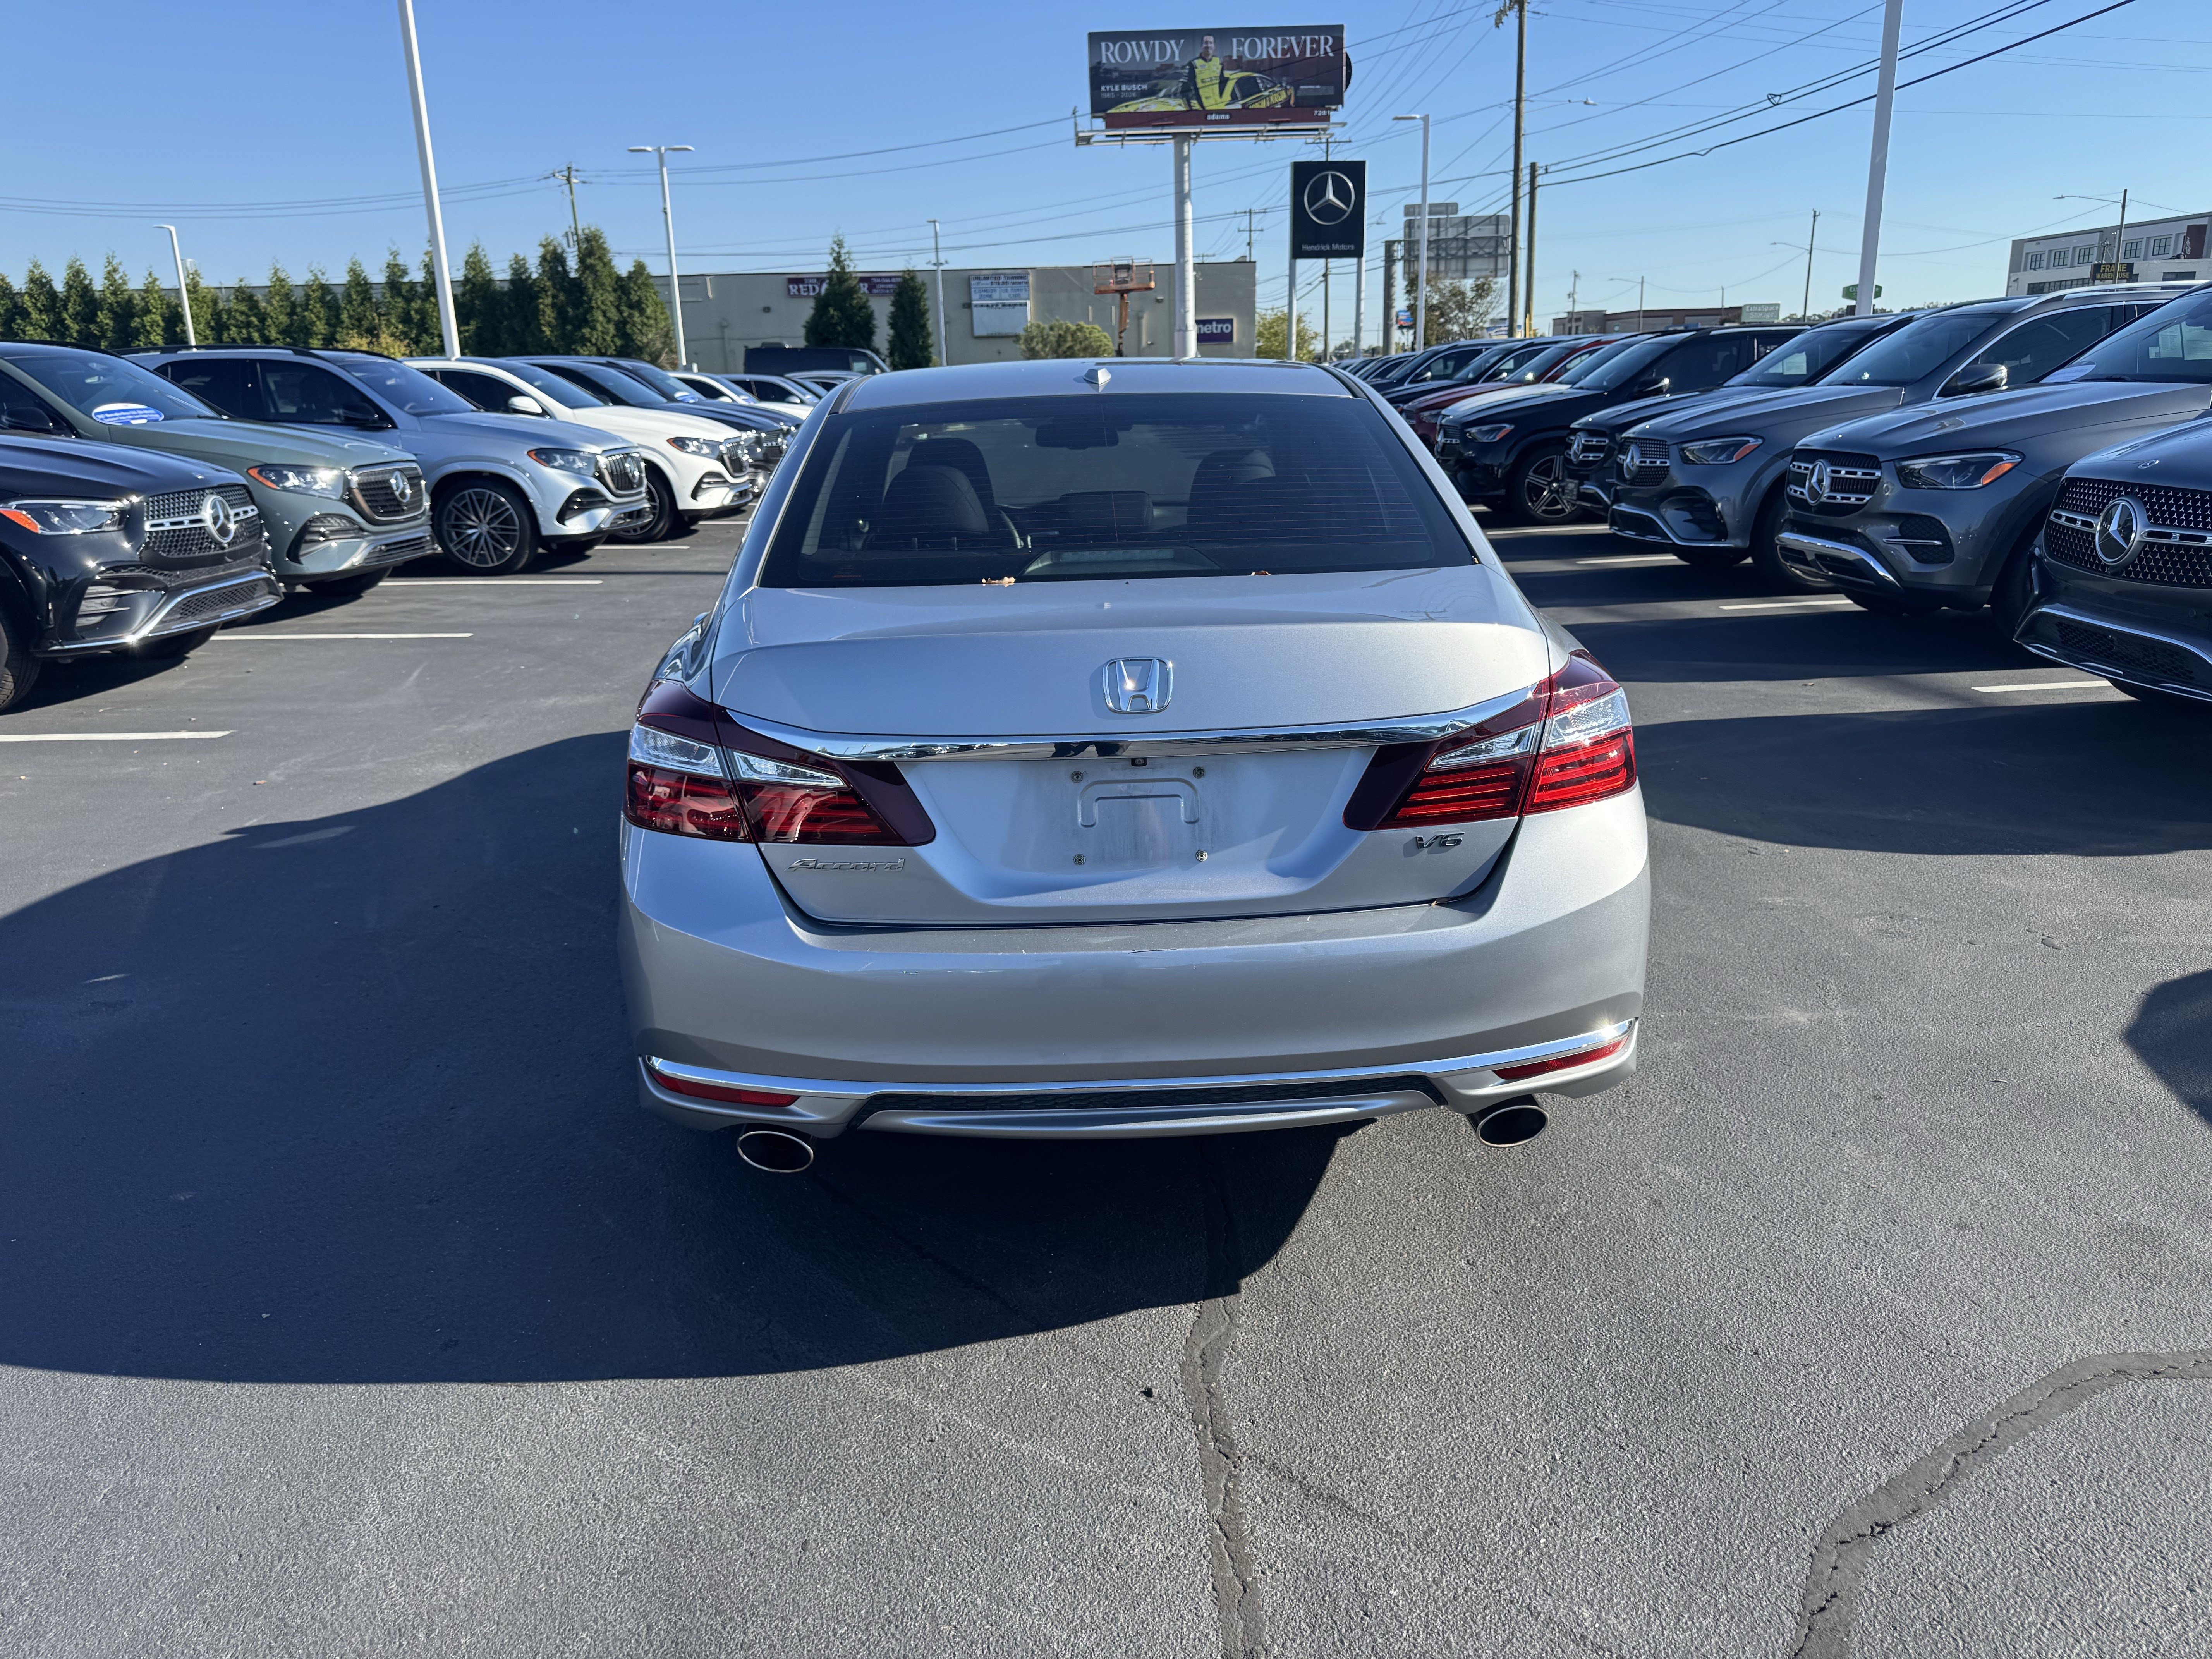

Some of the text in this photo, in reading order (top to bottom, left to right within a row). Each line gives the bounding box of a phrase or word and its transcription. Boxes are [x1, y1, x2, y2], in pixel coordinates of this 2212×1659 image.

[1101, 36, 1334, 63] ROWDY FOREVER
[789, 284, 819, 295] RED
[1416, 832, 1465, 849] V6
[783, 858, 905, 872] Accord
